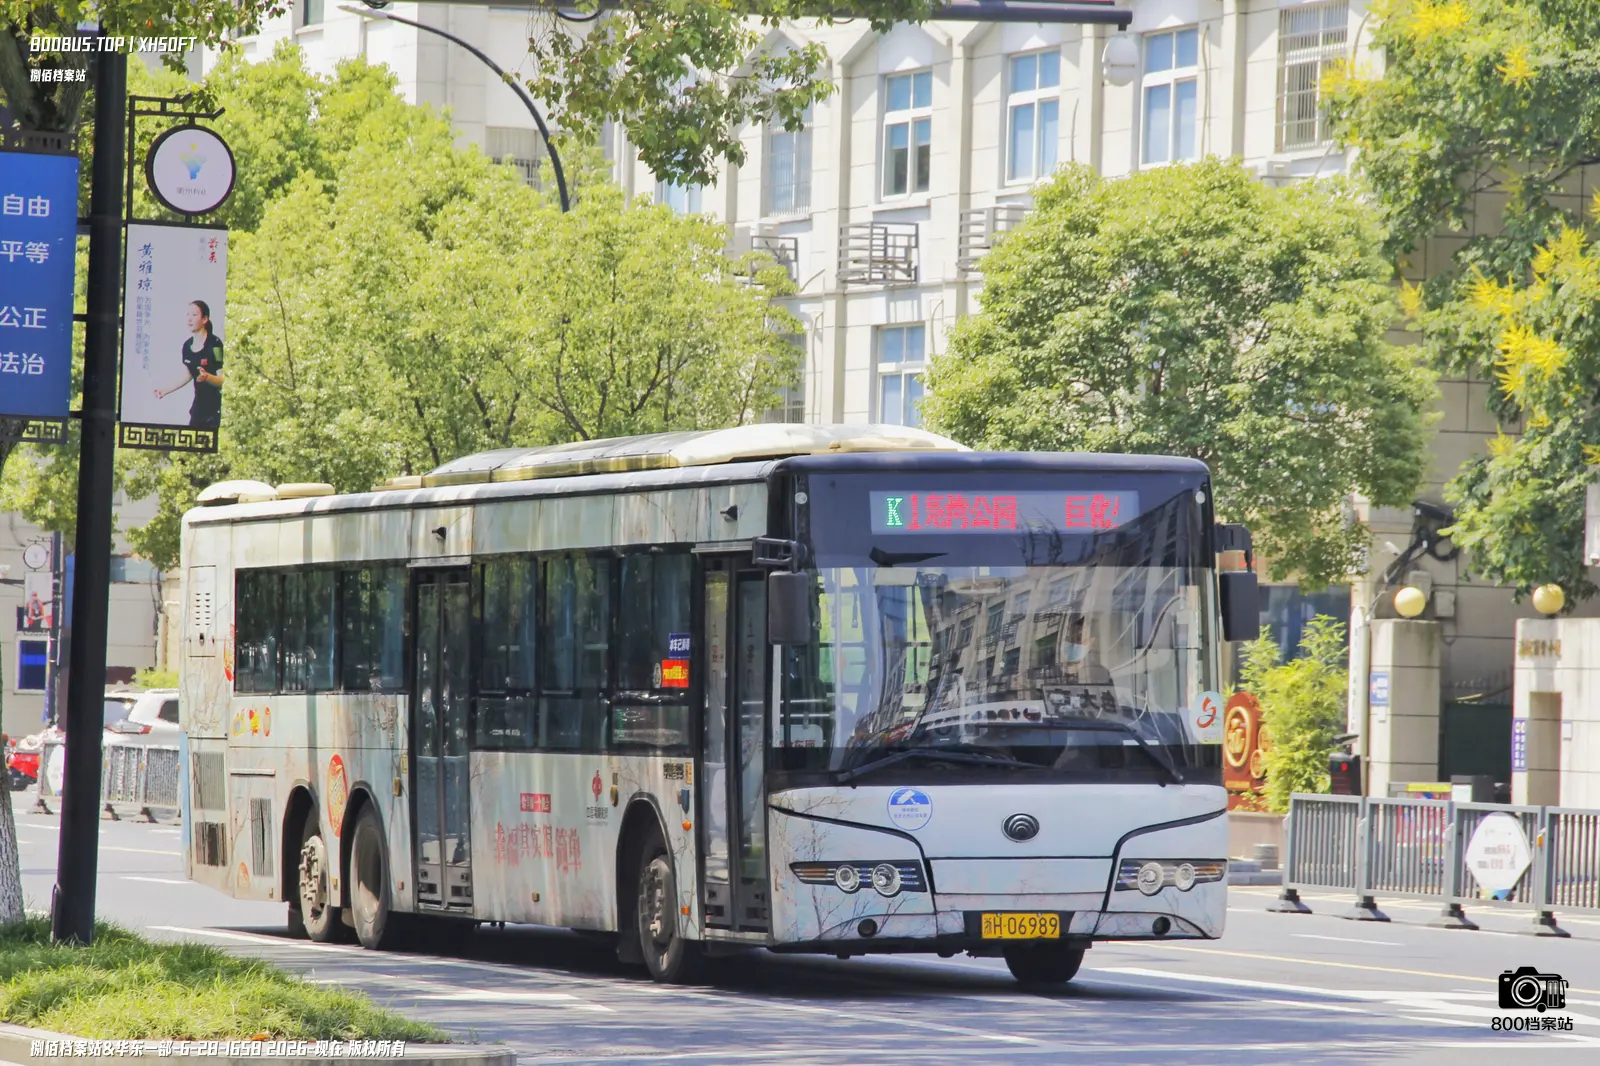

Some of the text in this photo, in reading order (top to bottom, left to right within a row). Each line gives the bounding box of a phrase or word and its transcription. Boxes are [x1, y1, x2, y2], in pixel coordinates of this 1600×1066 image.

[3, 194, 50, 217] 自由
[1, 240, 50, 264] 平等
[138, 243, 154, 291] 黄雅琼
[0, 306, 47, 329] 公正
[0, 351, 45, 375] 法治
